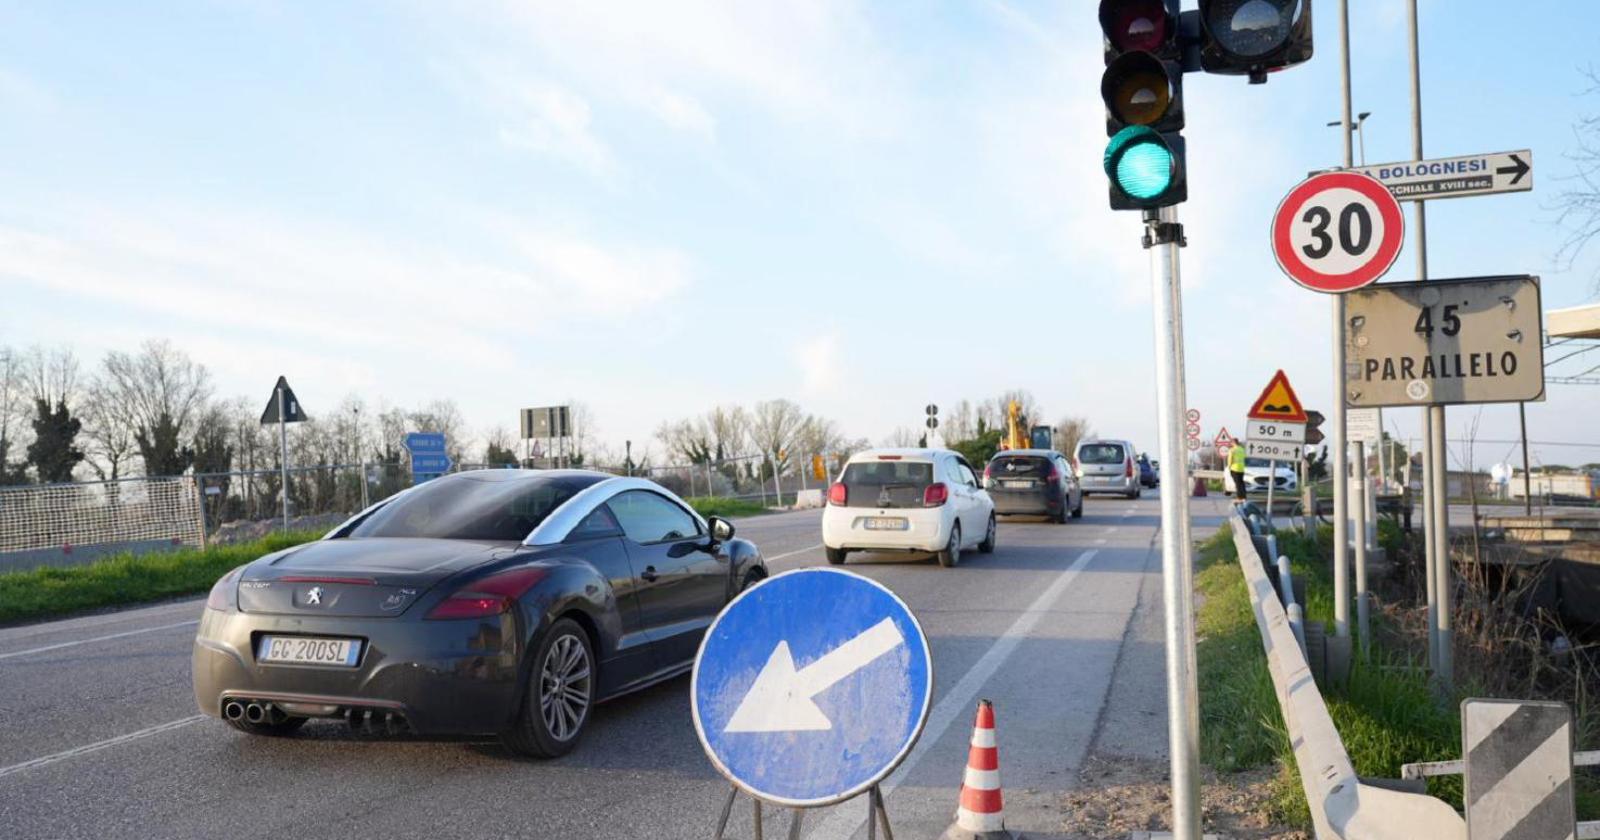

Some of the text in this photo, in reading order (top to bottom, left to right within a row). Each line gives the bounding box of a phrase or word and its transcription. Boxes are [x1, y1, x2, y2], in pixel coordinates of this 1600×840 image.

[1379, 159, 1487, 179] BOLOGNESI
[1468, 180, 1492, 189] sec.
[1302, 202, 1373, 260] 30
[1365, 350, 1518, 382] PARALLELO
[1259, 425, 1276, 436] 50
[1257, 445, 1279, 455] 200
[295, 640, 346, 662] 200SL
